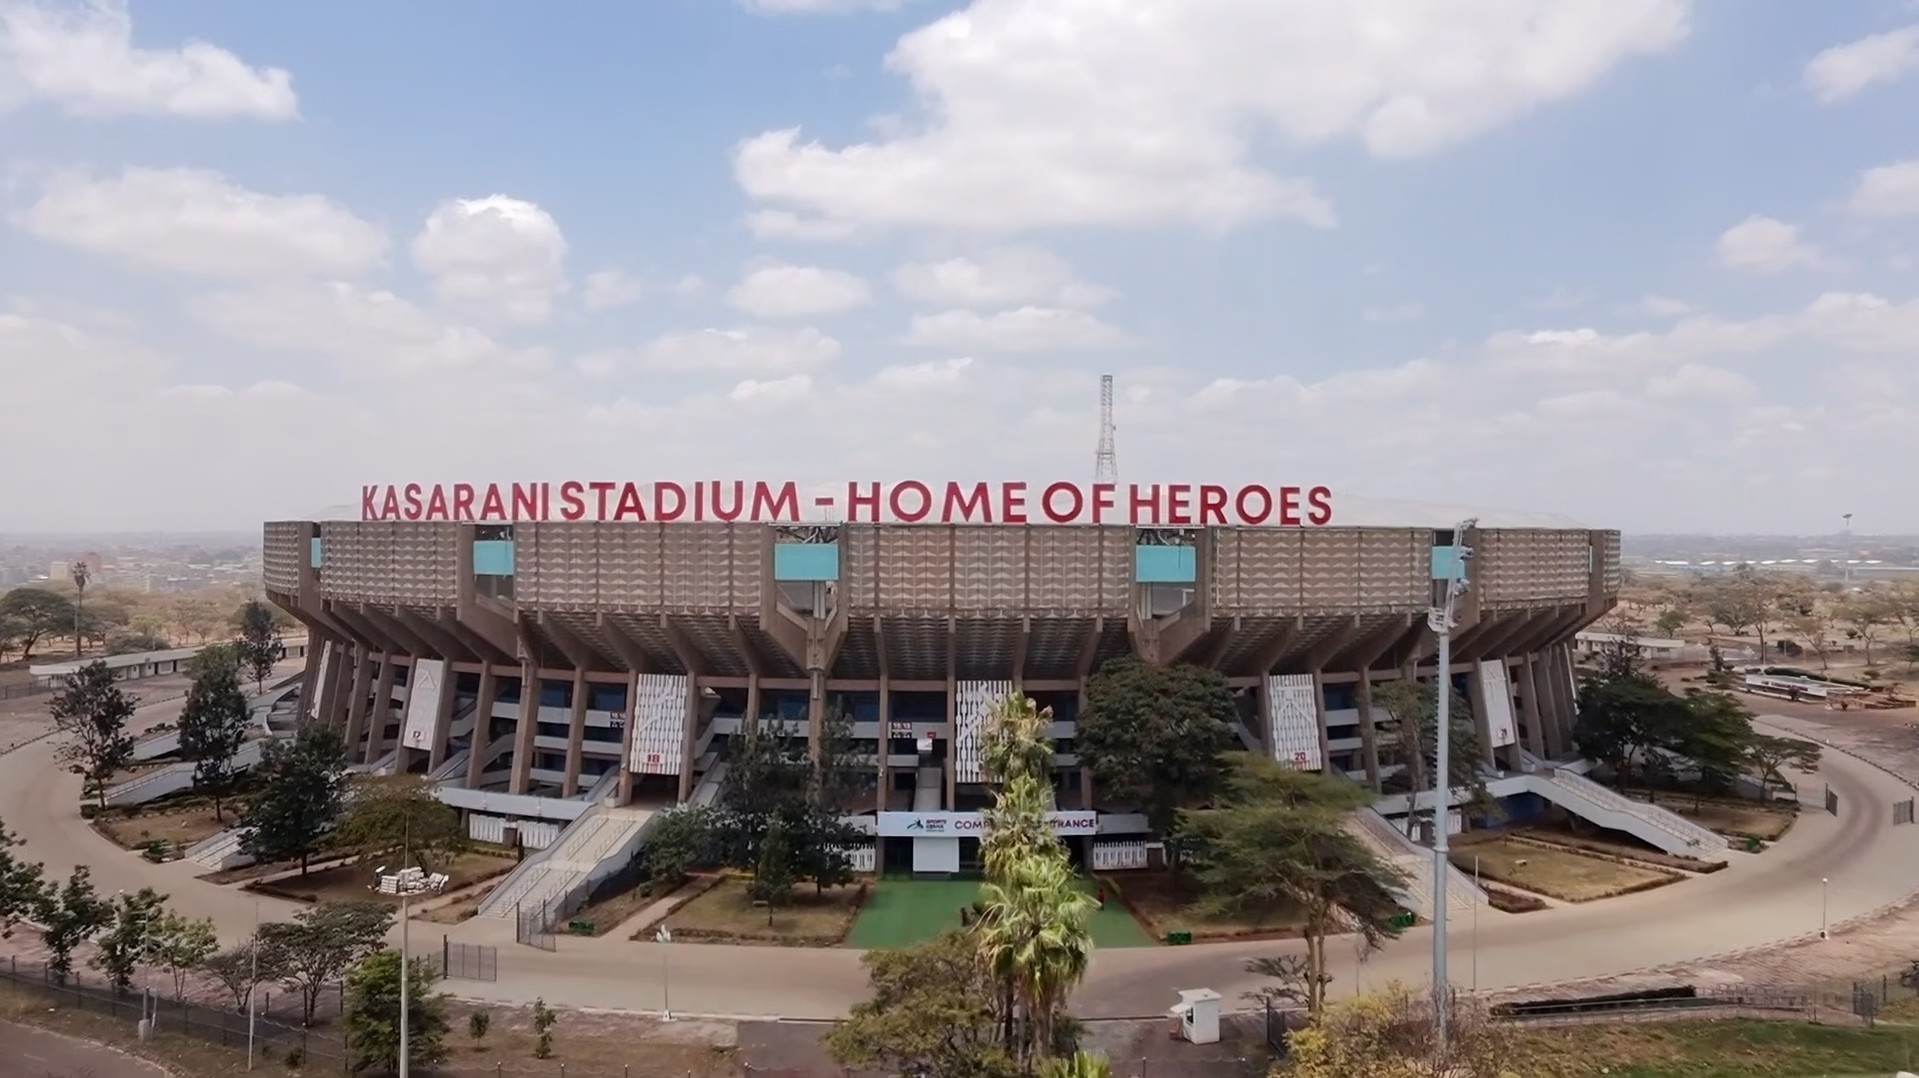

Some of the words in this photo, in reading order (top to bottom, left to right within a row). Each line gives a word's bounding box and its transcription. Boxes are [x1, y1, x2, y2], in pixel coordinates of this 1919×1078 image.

[362, 481, 549, 521] KASARANI
[559, 480, 800, 522] STADIUM
[847, 480, 1027, 523] HOME
[1042, 481, 1117, 524] OF
[1129, 483, 1333, 525] HEROES
